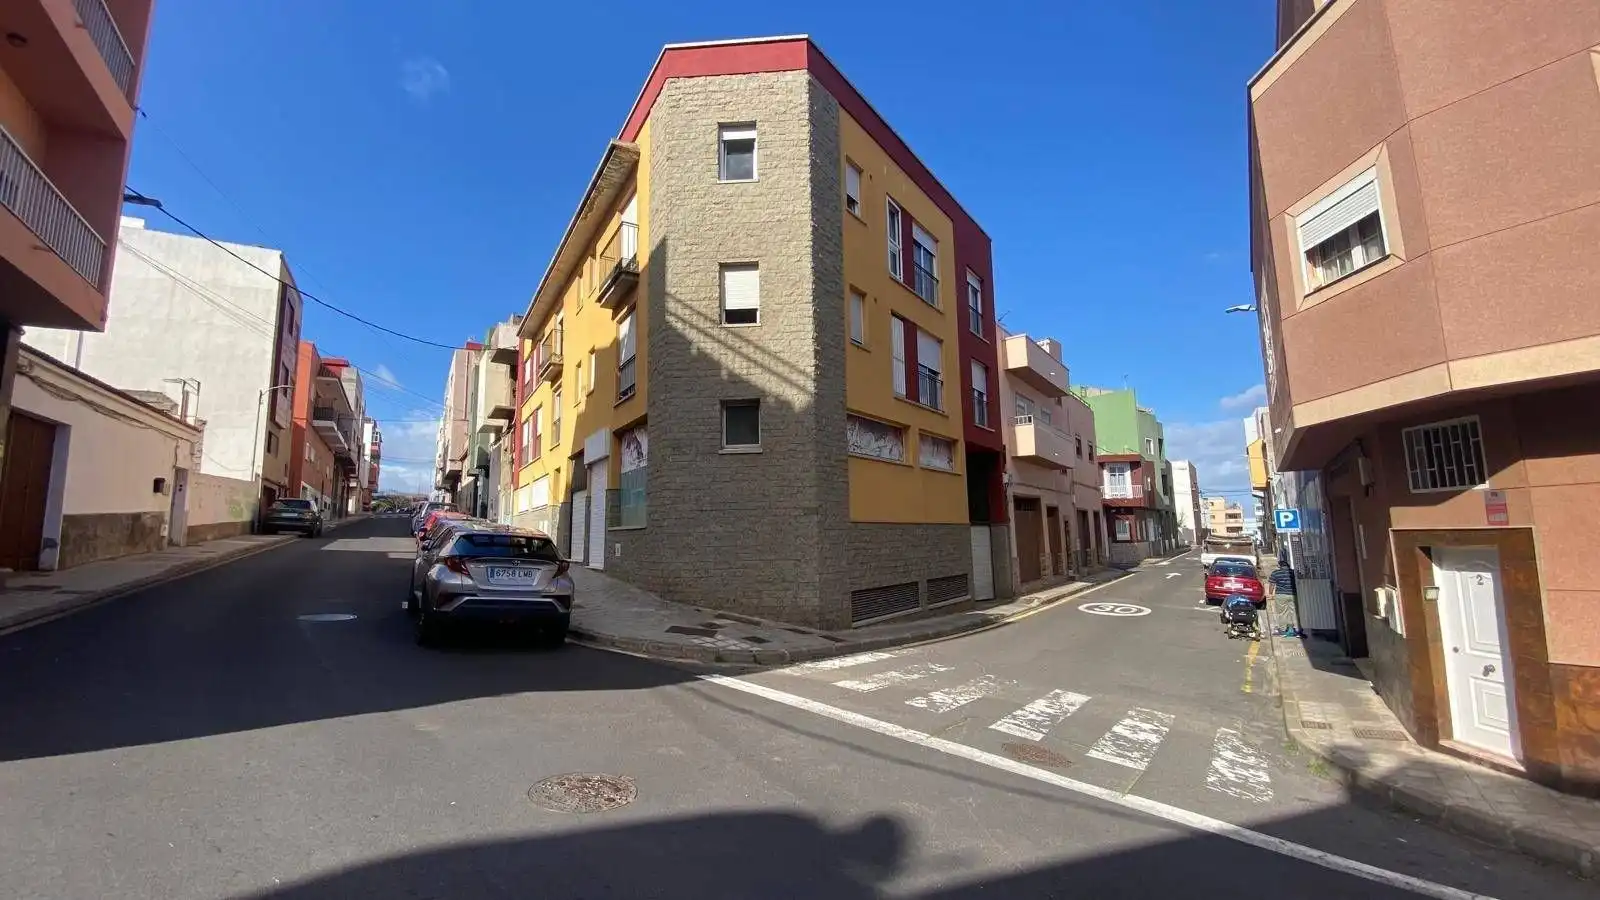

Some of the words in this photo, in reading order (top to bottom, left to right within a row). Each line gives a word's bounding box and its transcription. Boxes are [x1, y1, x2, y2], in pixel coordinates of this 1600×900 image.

[1279, 511, 1294, 528] P
[495, 569, 516, 578] 6758
[1475, 574, 1485, 586] 2
[1093, 604, 1138, 614] 30
